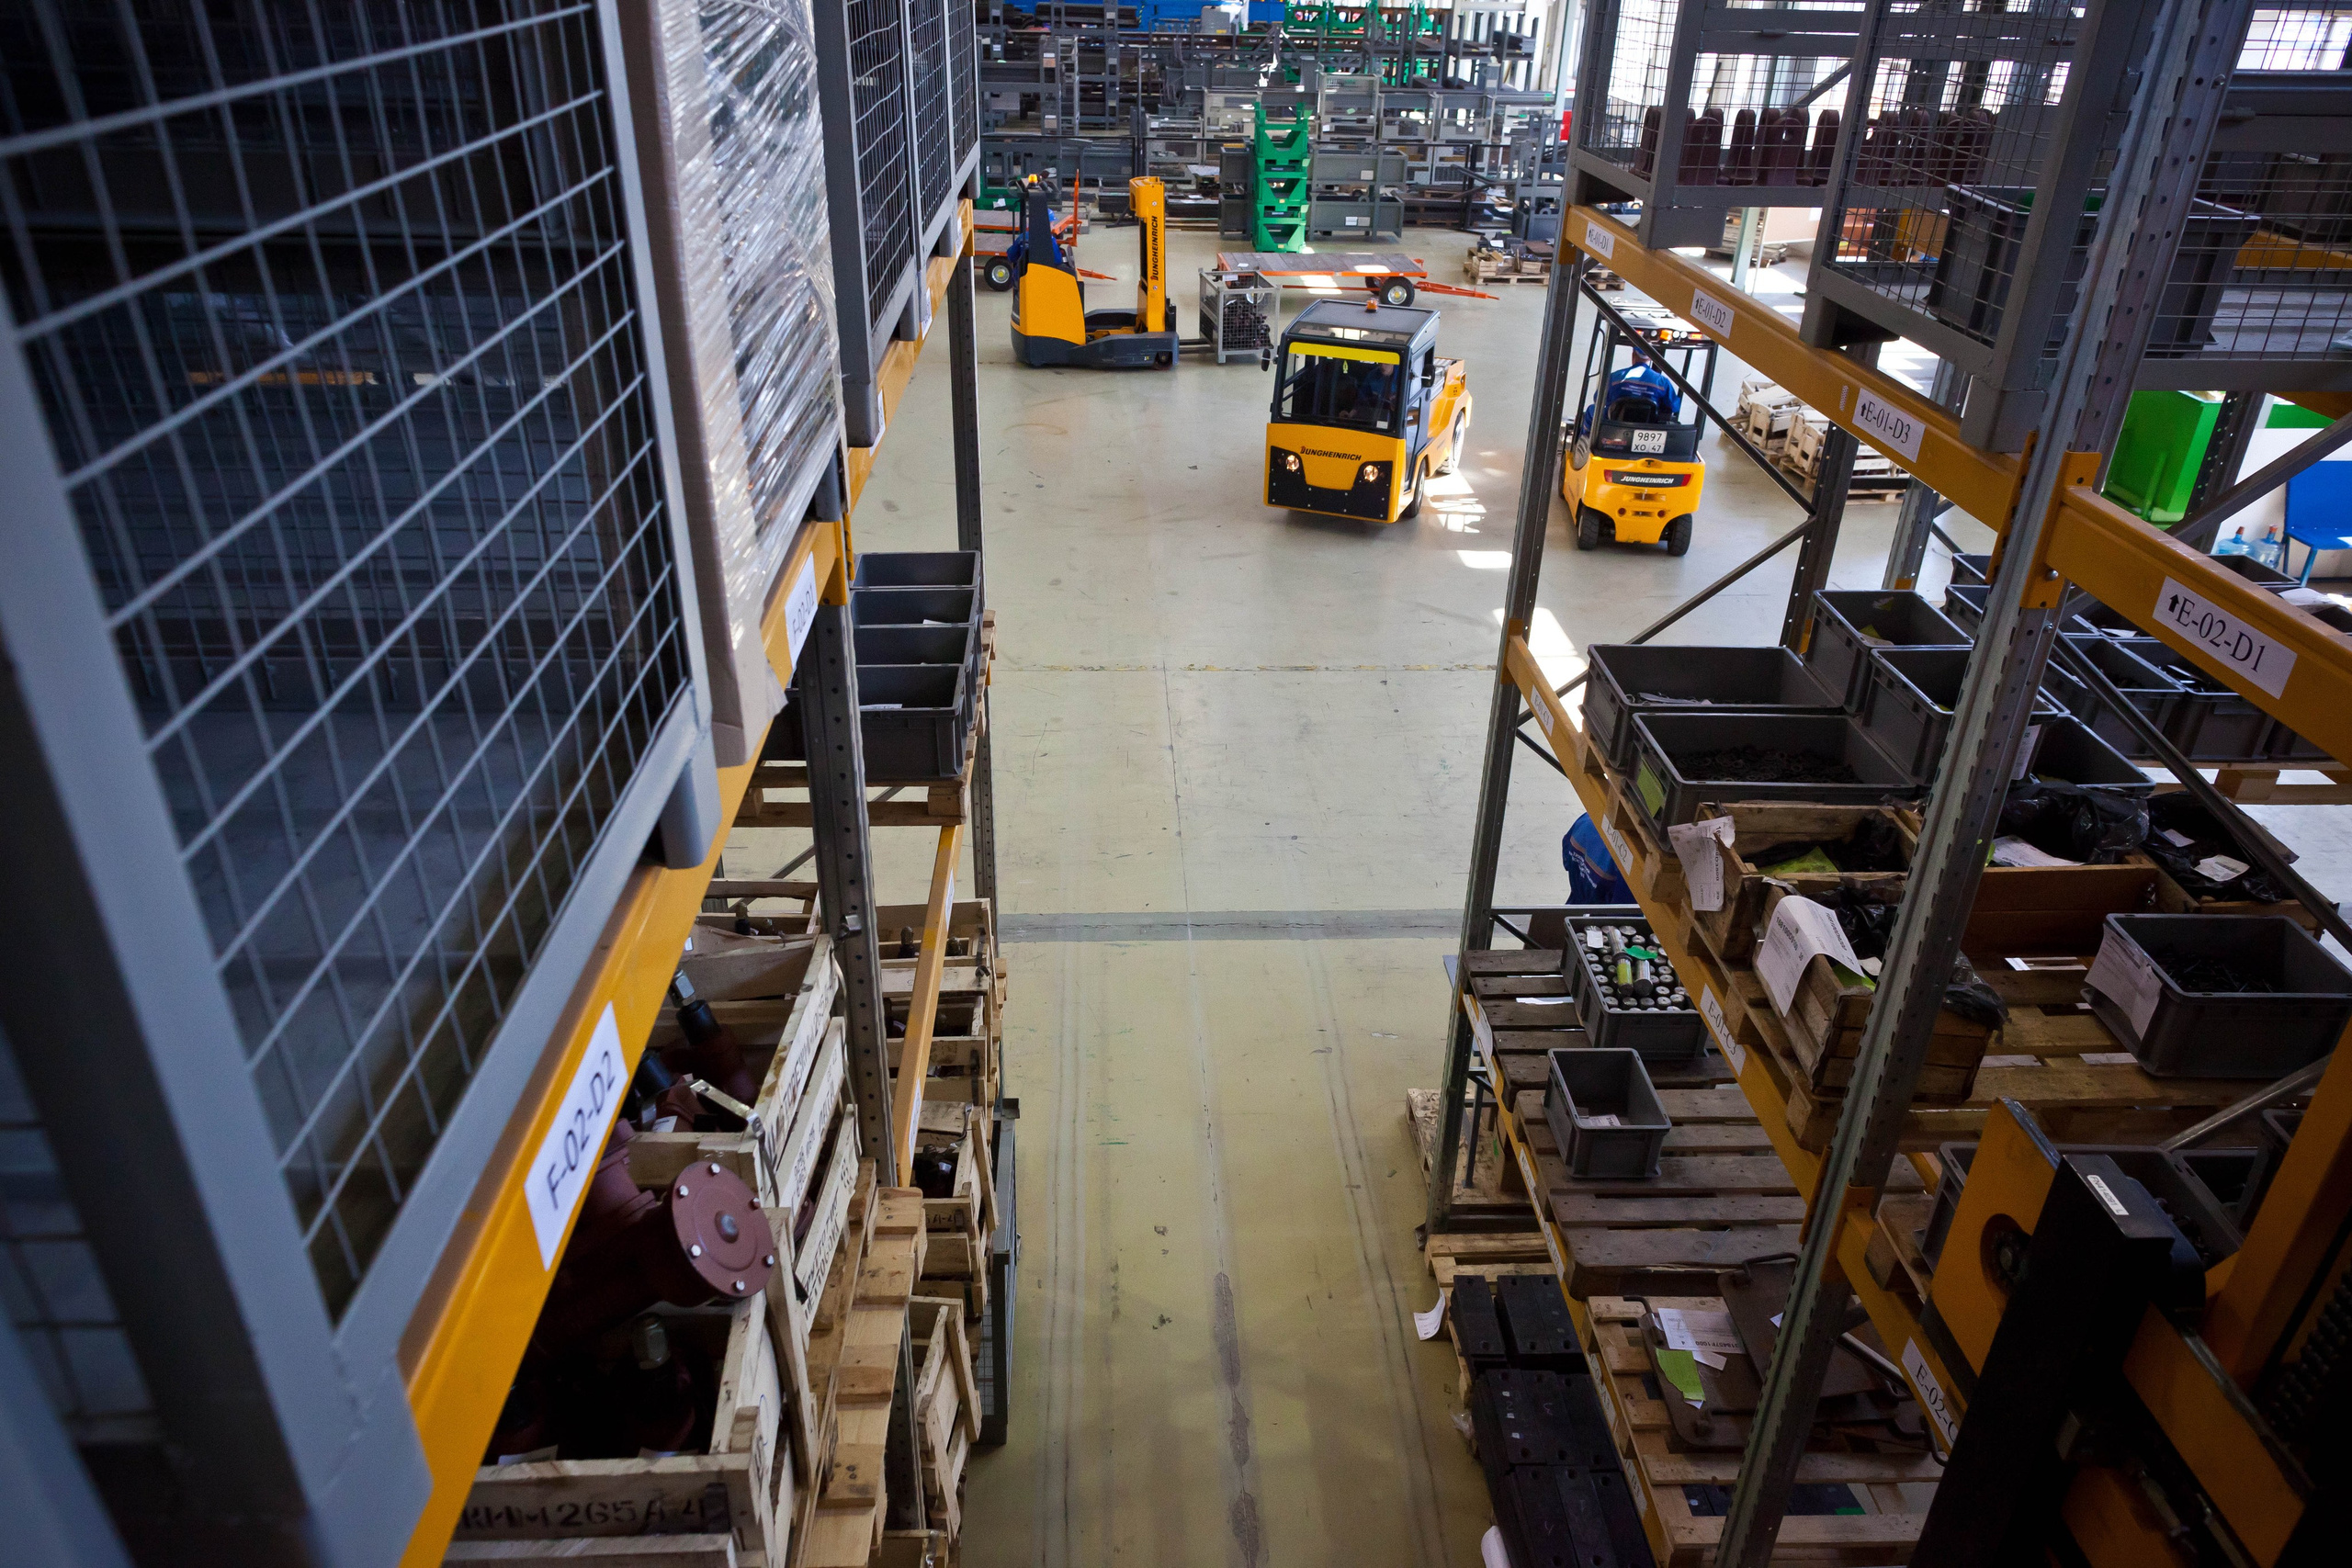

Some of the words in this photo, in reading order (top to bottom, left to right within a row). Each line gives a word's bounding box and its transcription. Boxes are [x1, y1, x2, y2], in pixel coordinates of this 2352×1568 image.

[1150, 216, 1159, 280] JUNGHEINRICH
[1699, 299, 1726, 328] E-01-D2
[1865, 400, 1911, 444] E-01-D3
[1638, 432, 1662, 442] 9897
[1300, 446, 1362, 461] JUNGHEINRICH
[1621, 473, 1674, 484] JUNGHEINRICH
[2175, 596, 2266, 672] E-02-D1
